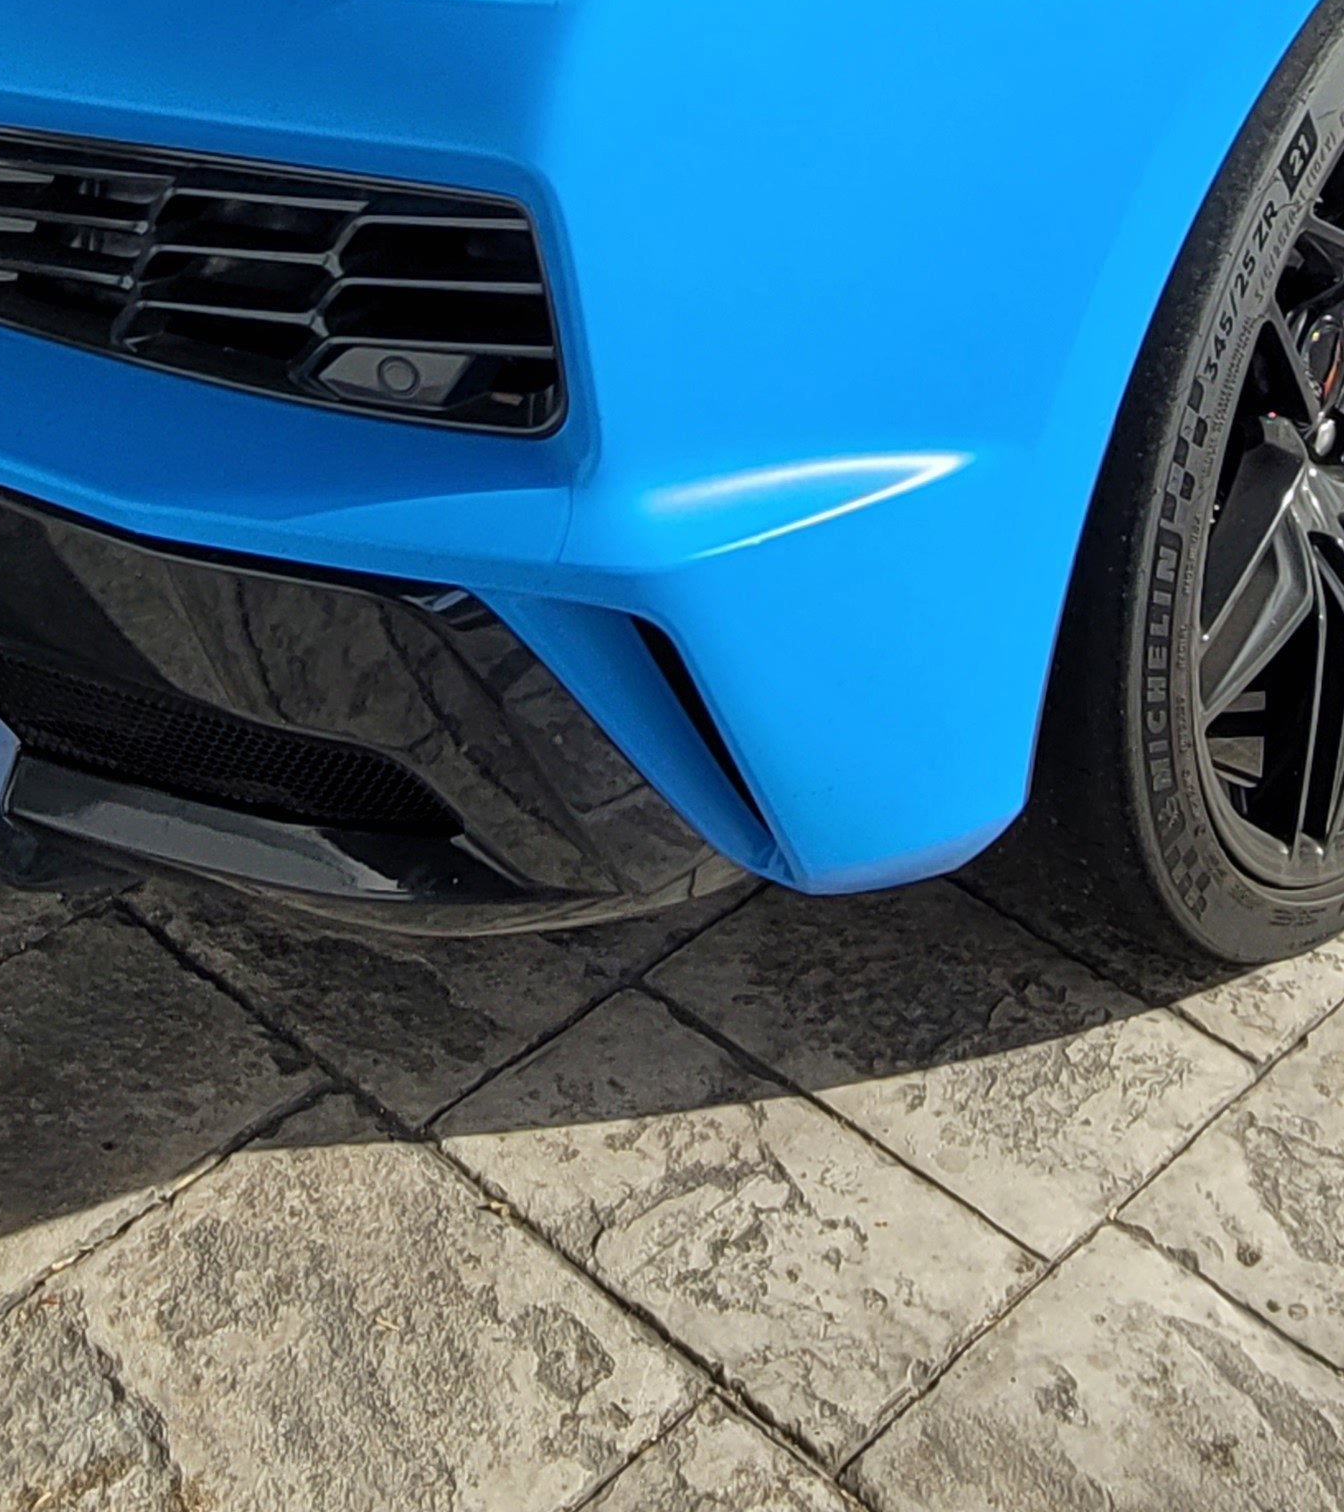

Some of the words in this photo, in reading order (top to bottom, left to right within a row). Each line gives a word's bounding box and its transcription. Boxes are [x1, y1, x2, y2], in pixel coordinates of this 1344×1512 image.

[1253, 200, 1278, 252] ZR
[1289, 133, 1311, 177] 21
[1146, 545, 1178, 792] MICHELIN
